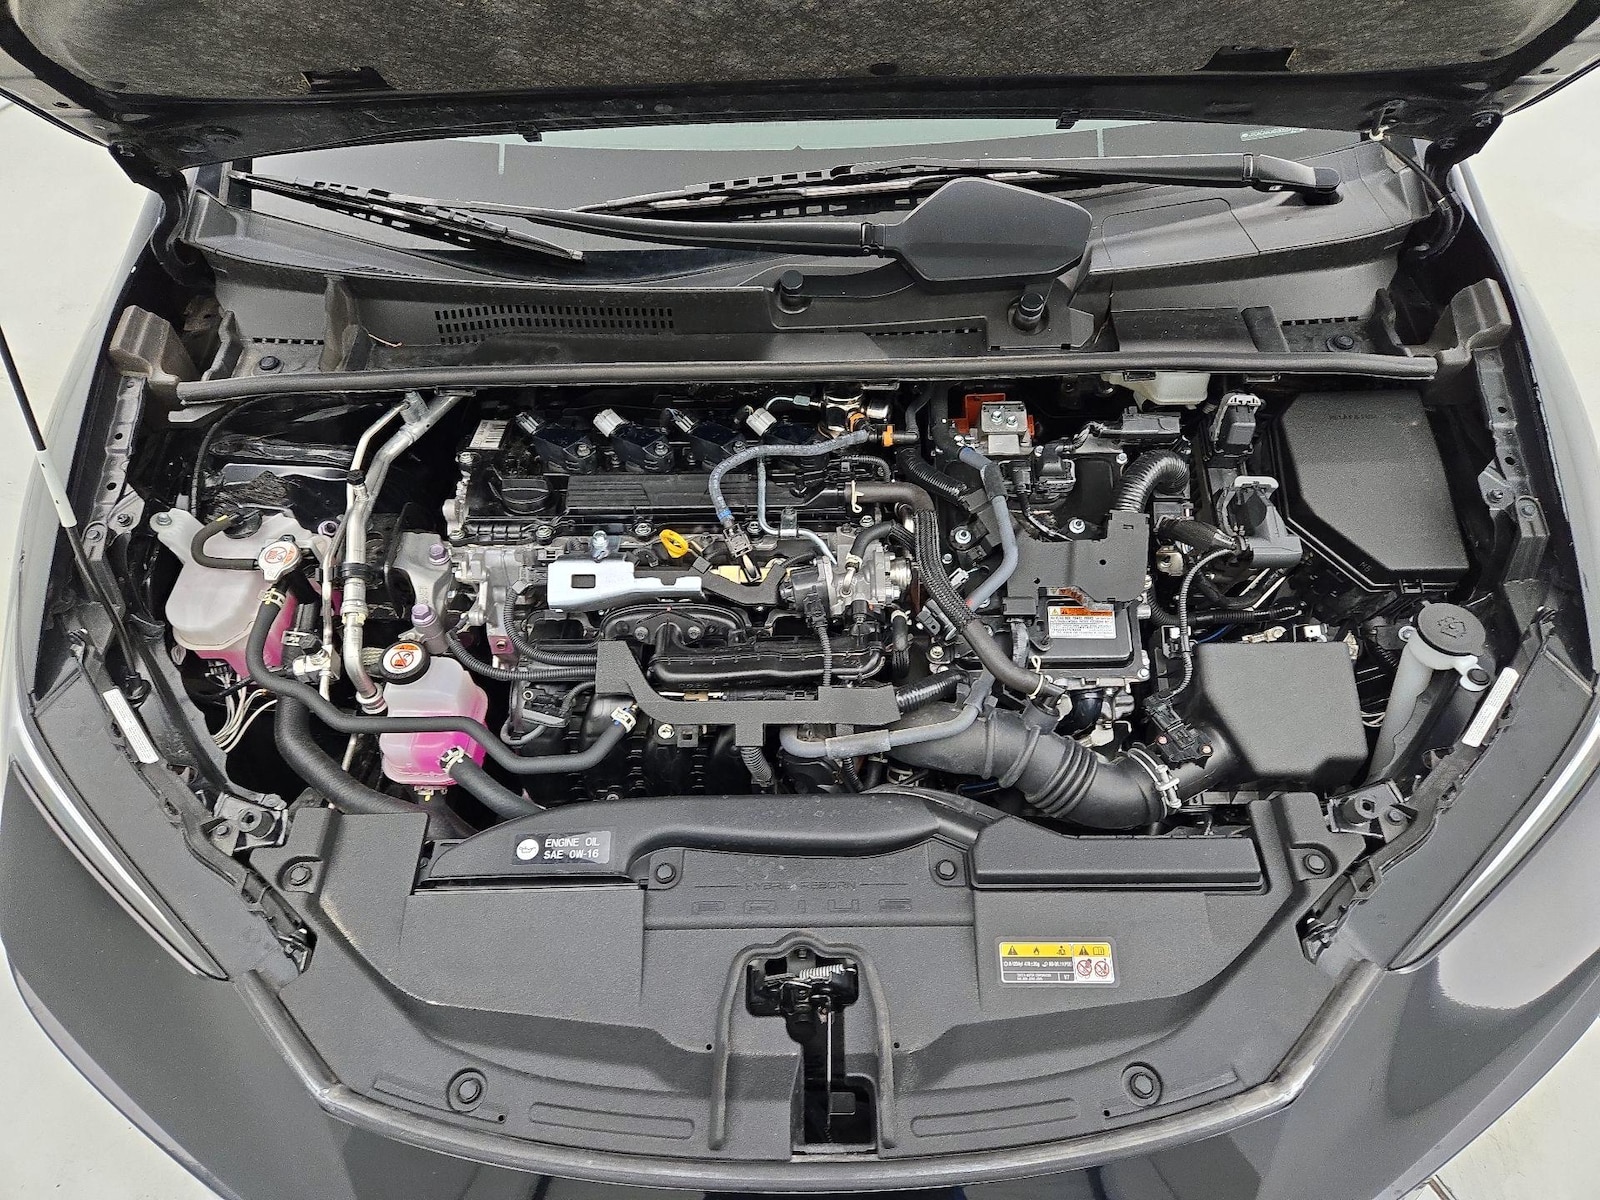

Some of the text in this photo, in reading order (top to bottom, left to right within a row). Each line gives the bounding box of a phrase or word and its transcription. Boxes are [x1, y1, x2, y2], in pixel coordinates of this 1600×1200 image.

[544, 837, 600, 848] ENGINE OIL
[543, 849, 599, 860] SAE 0W-16
[691, 898, 913, 914] PRIUS
